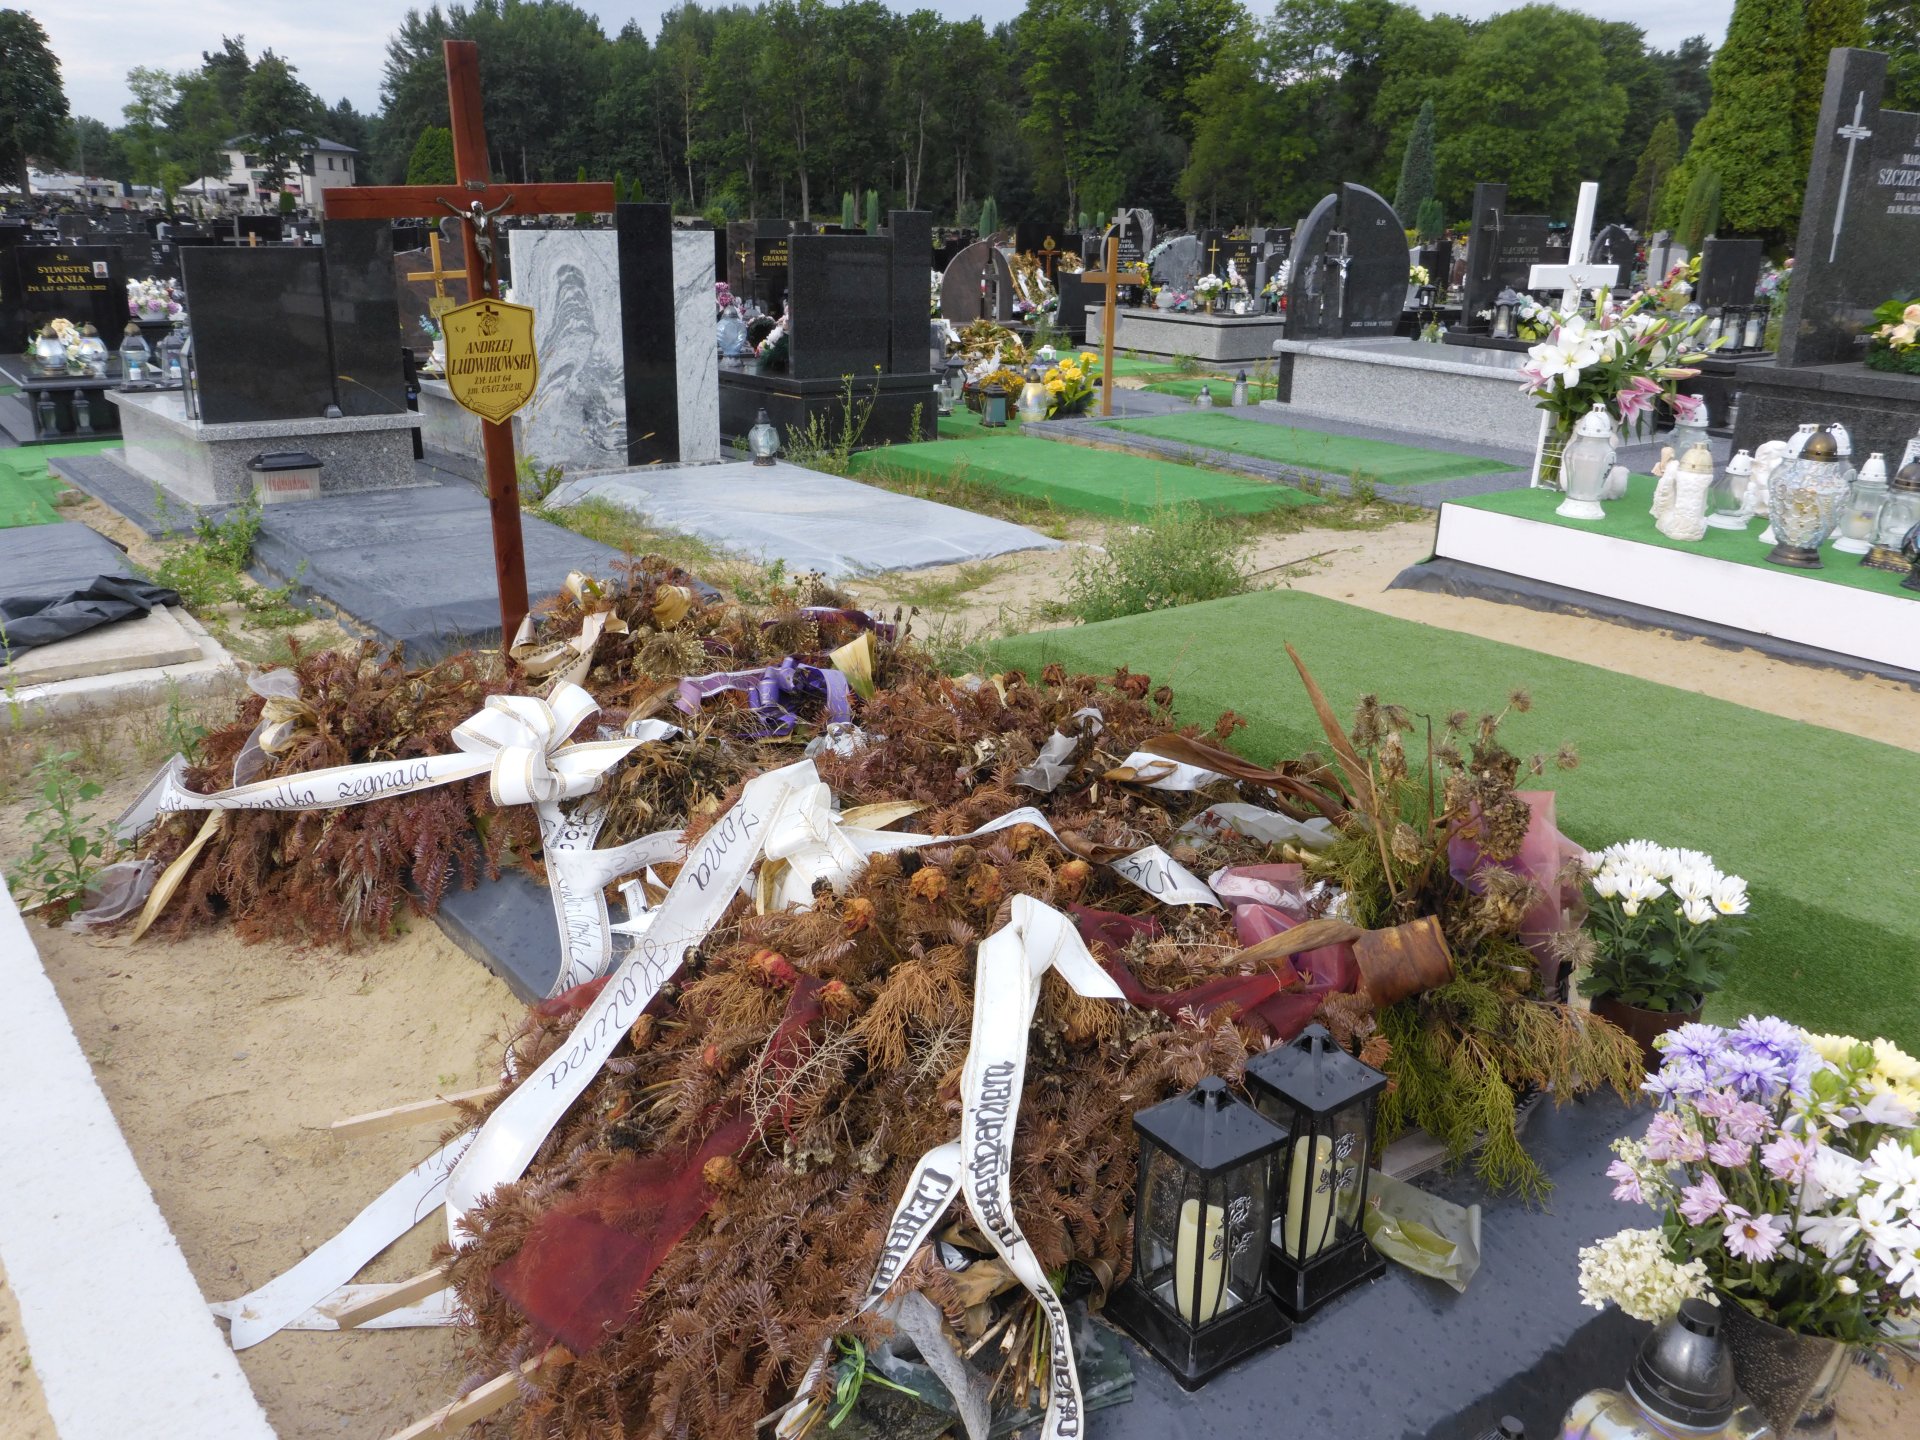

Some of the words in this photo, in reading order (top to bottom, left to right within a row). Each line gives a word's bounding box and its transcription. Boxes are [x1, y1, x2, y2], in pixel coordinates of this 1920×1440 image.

[37, 265, 92, 274] SYLWESTER
[46, 275, 86, 284] KANIA
[465, 338, 514, 355] ANDRZEJ
[451, 353, 532, 376] LUDWIKOWSKI
[488, 375, 501, 384] LAT
